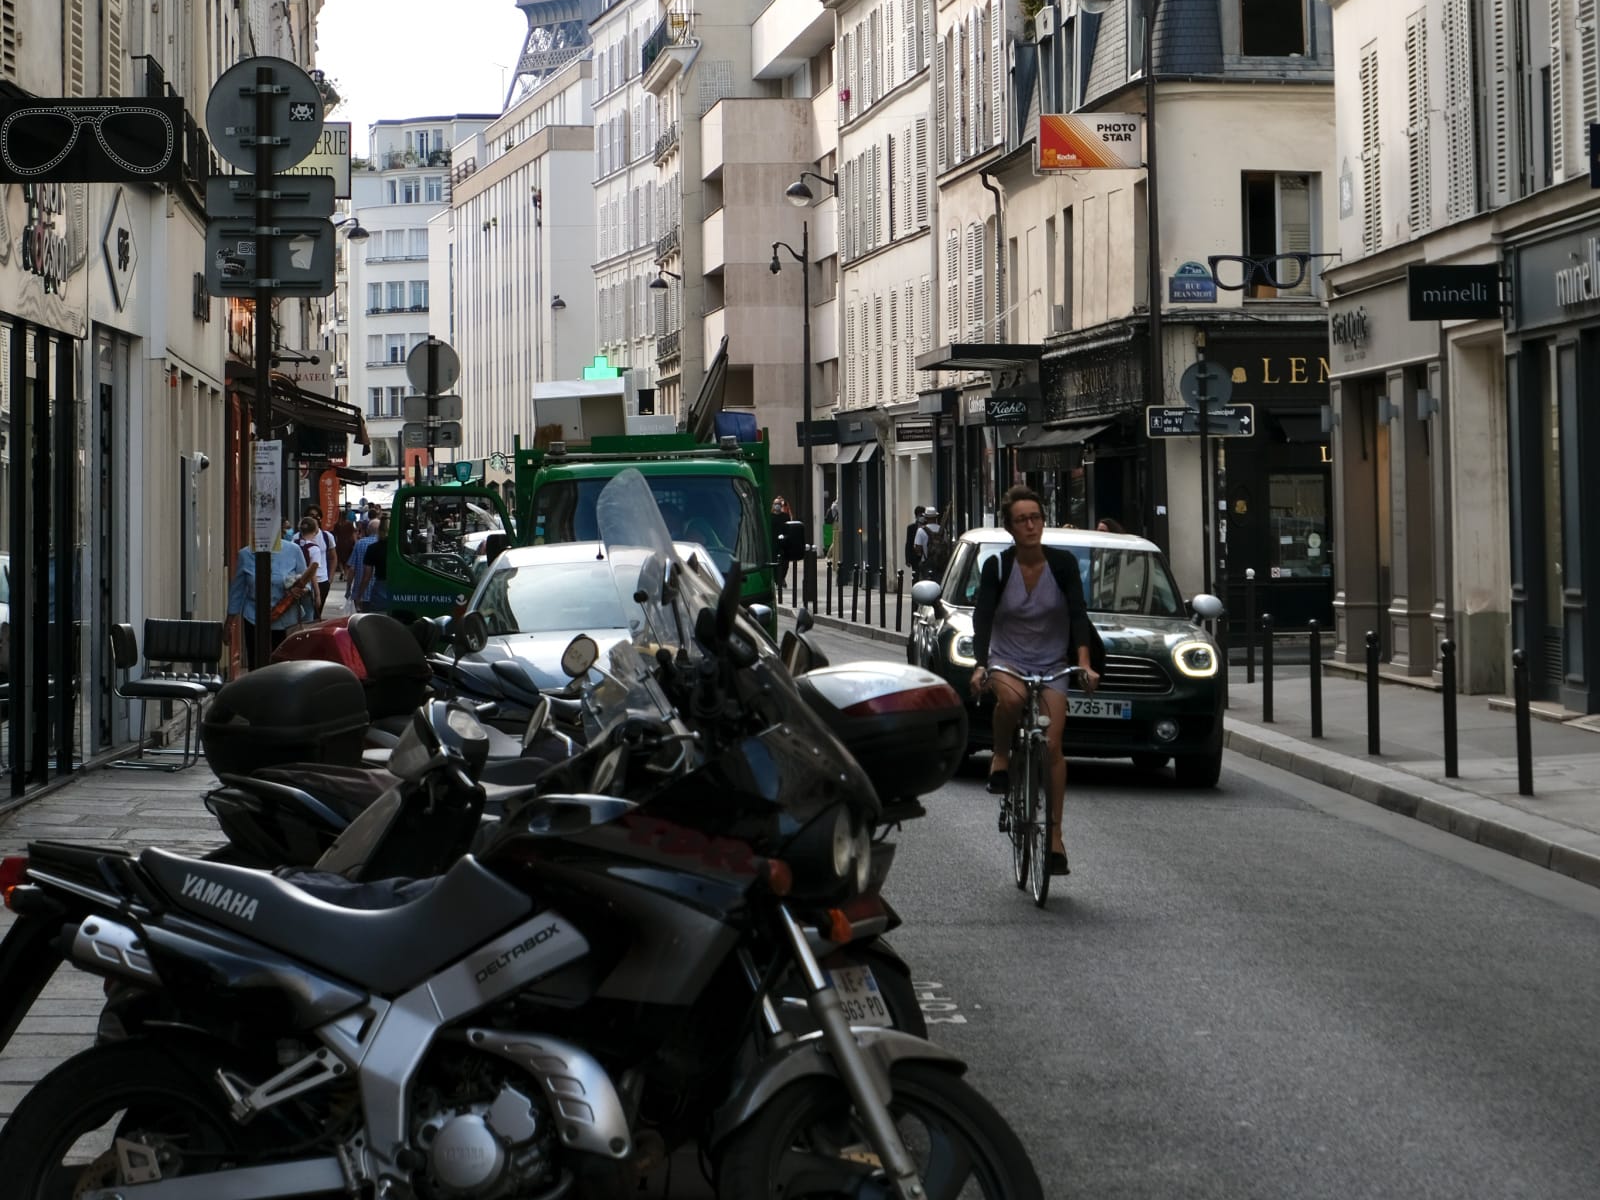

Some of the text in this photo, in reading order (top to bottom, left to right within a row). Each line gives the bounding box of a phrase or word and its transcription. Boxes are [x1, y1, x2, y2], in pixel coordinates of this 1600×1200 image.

[1096, 123, 1137, 132] PHOTO
[1102, 133, 1132, 142] STAR
[1056, 153, 1077, 161] Kodak
[1185, 282, 1201, 290] RUE
[1422, 282, 1488, 302] minelli
[987, 401, 1026, 415] Kiehl's
[392, 594, 452, 603] MAIRIE DE PARIS
[180, 872, 259, 921] YAMAHA
[472, 921, 561, 985] DELTABOX
